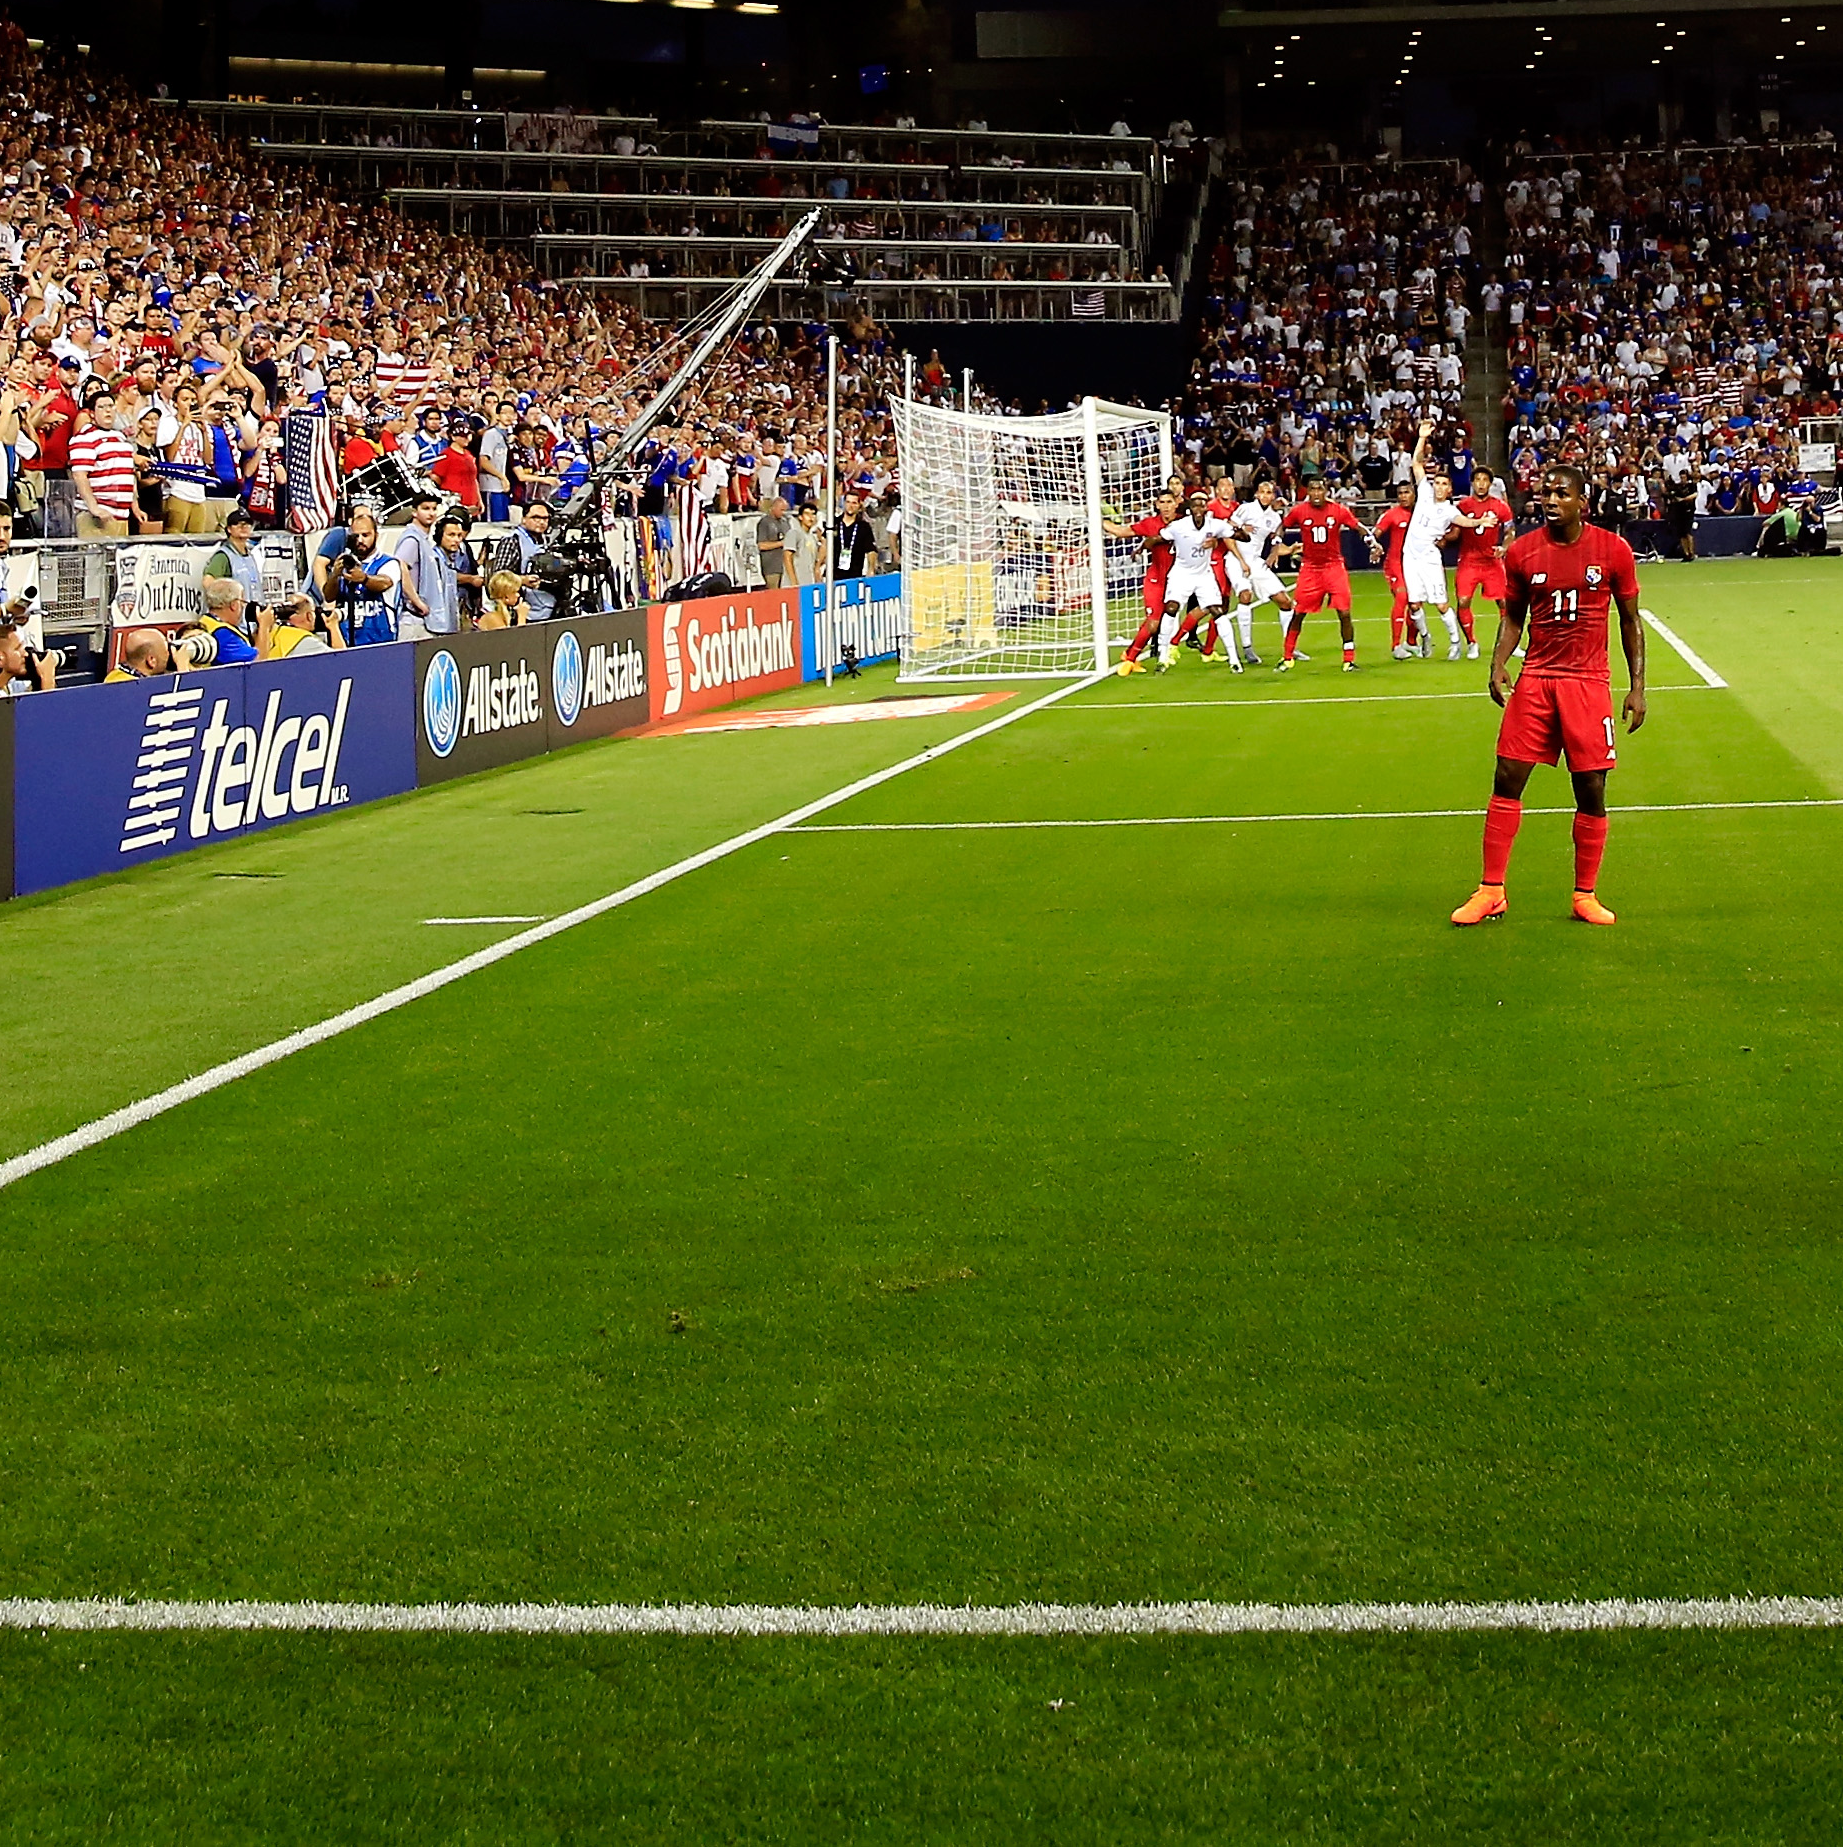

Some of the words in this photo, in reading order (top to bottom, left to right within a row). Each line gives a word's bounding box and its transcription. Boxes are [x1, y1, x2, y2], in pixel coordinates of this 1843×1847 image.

[1191, 546, 1206, 559] 20
[1311, 526, 1327, 544] 10
[148, 553, 193, 577] American
[136, 571, 204, 620] Outlaws
[1551, 589, 1579, 622] 11
[687, 602, 795, 693] Scotiabank
[462, 658, 540, 738] Allstate
[583, 639, 645, 710] Allstate
[190, 677, 354, 839] telcel
